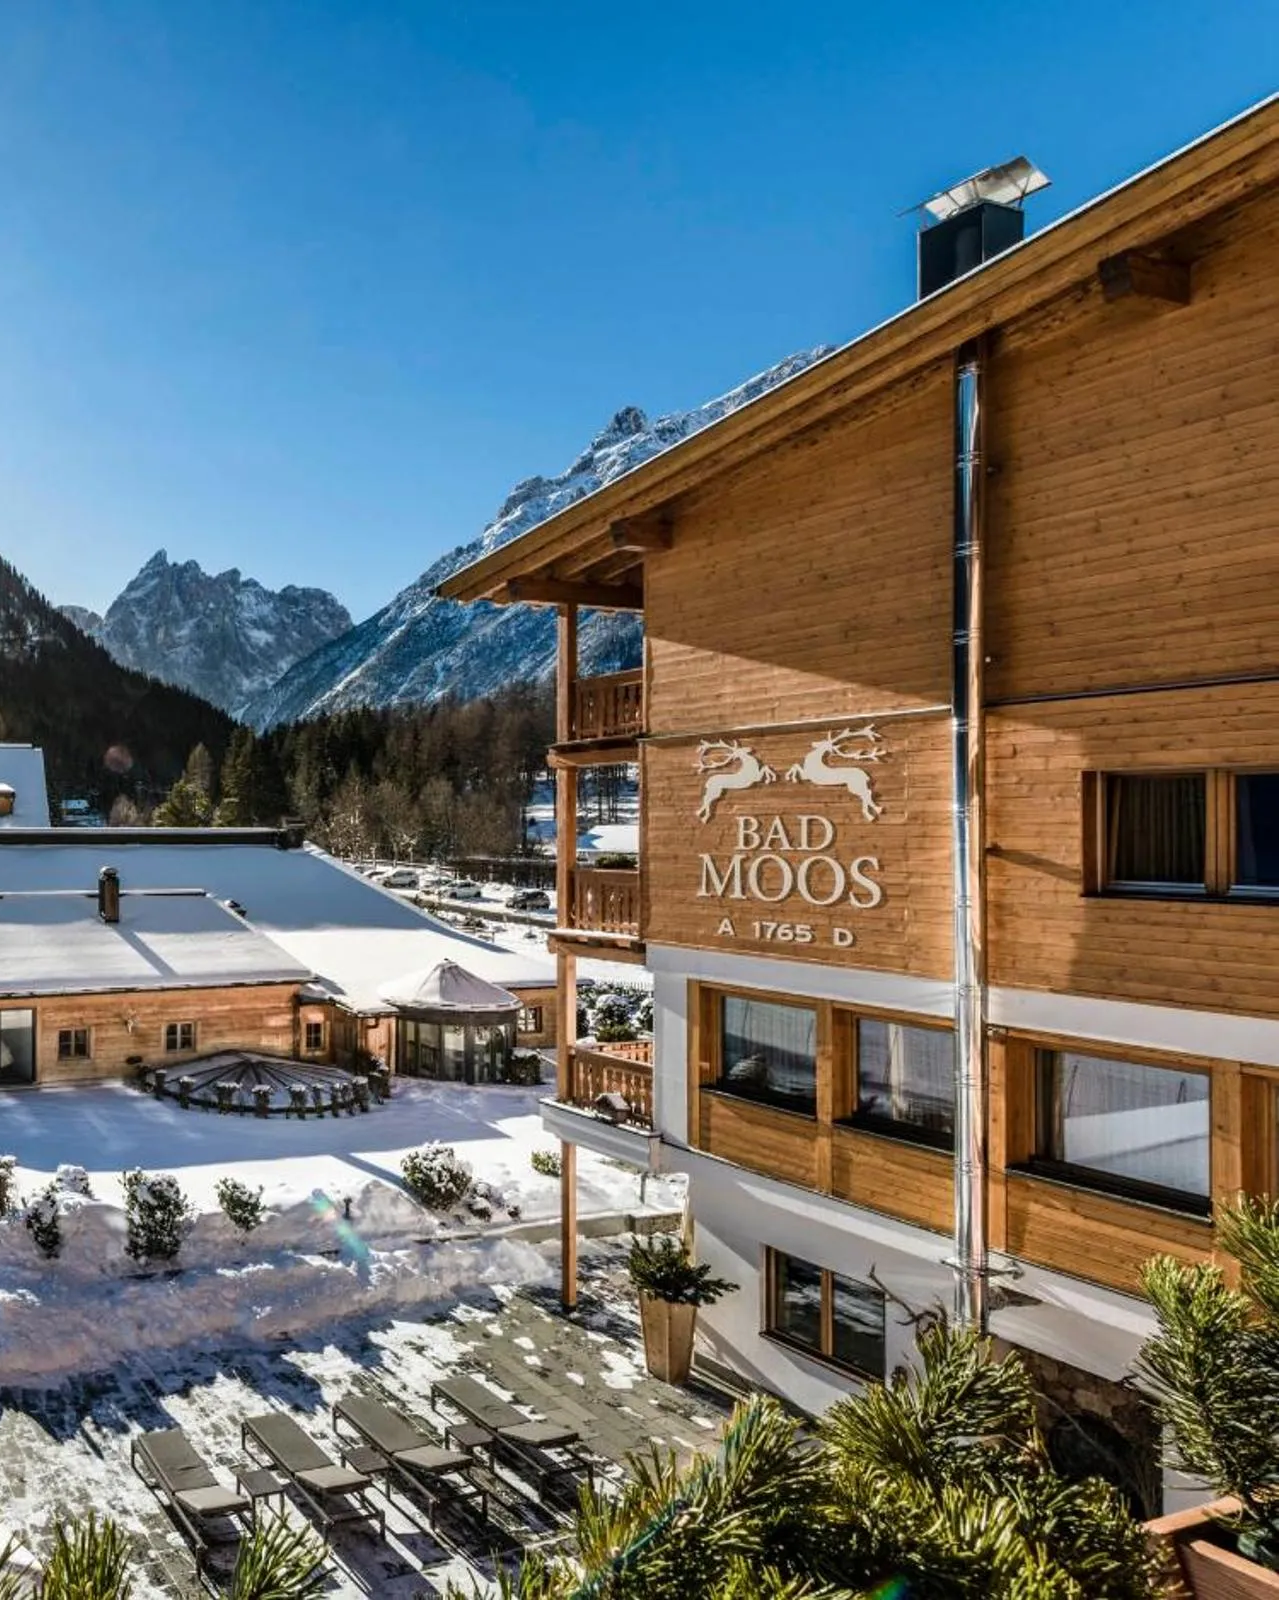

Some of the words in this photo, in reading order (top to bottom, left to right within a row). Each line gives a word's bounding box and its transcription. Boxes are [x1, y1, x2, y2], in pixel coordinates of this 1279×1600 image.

[736, 815, 833, 850] BAD
[697, 853, 882, 908] MOOS
[718, 918, 735, 936] A
[753, 921, 813, 942] 1765
[833, 928, 853, 947] D
